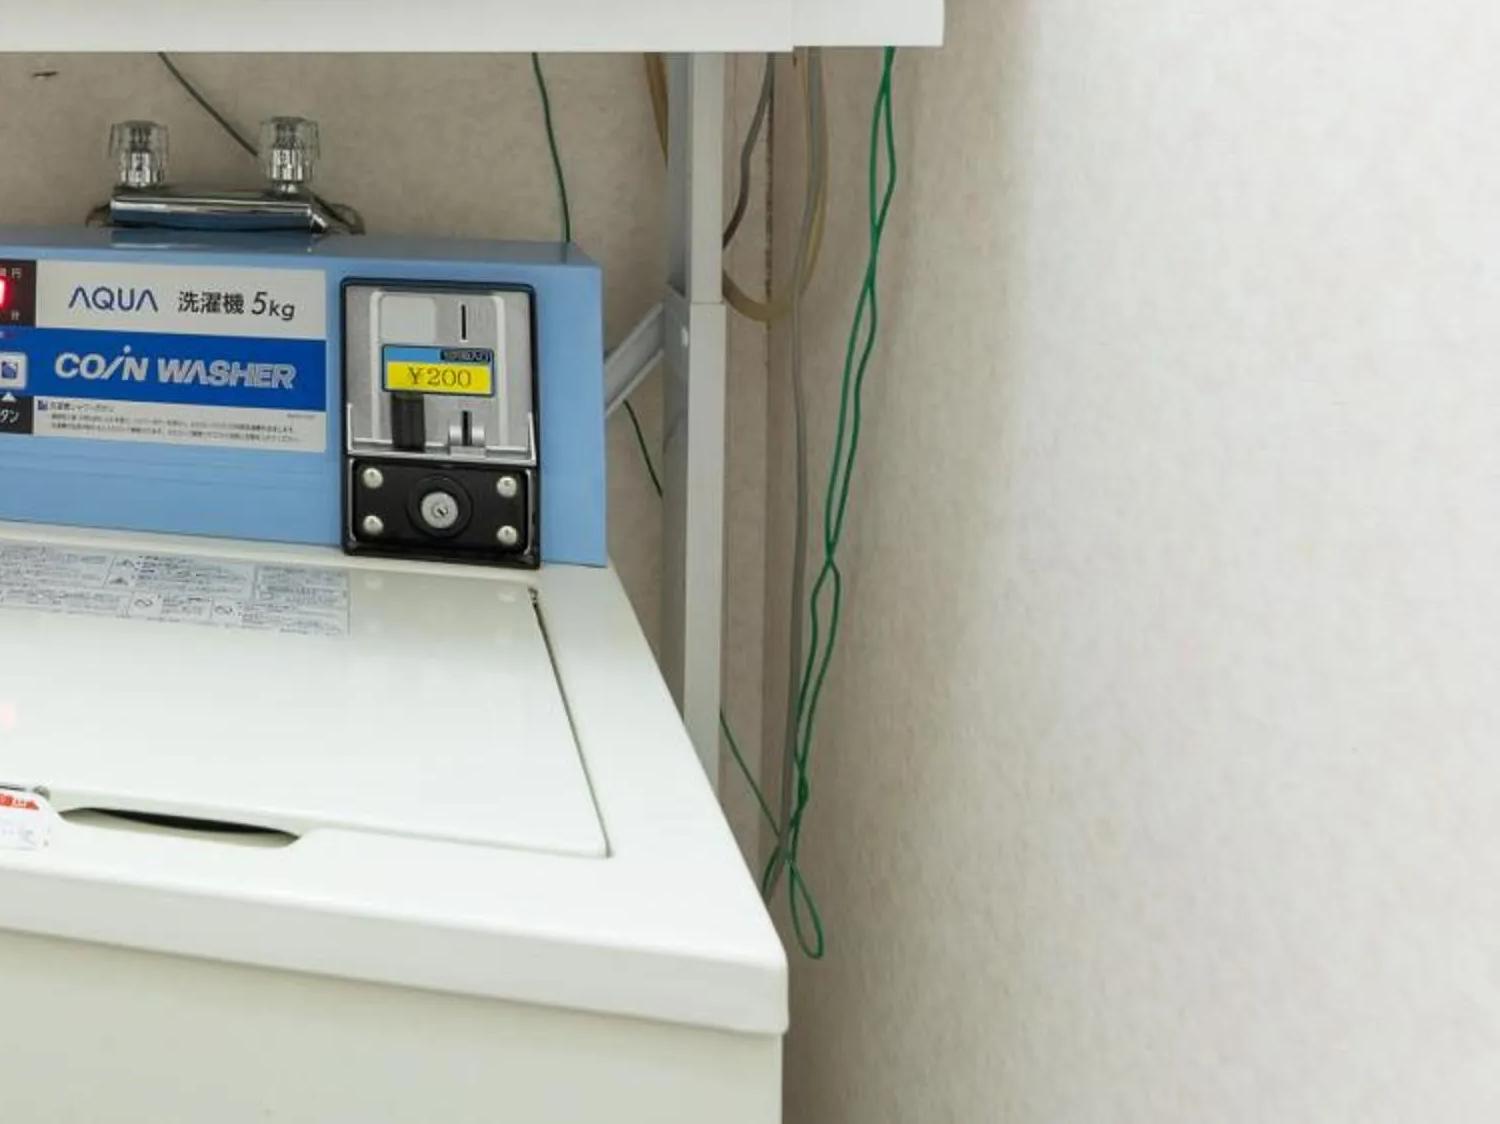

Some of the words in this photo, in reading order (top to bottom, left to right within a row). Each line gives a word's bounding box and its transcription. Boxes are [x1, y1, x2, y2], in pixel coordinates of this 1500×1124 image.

[68, 286, 159, 313] AQUA
[177, 291, 245, 315] 洗濯機
[251, 292, 296, 321] 5kg
[157, 356, 297, 390] WASHER
